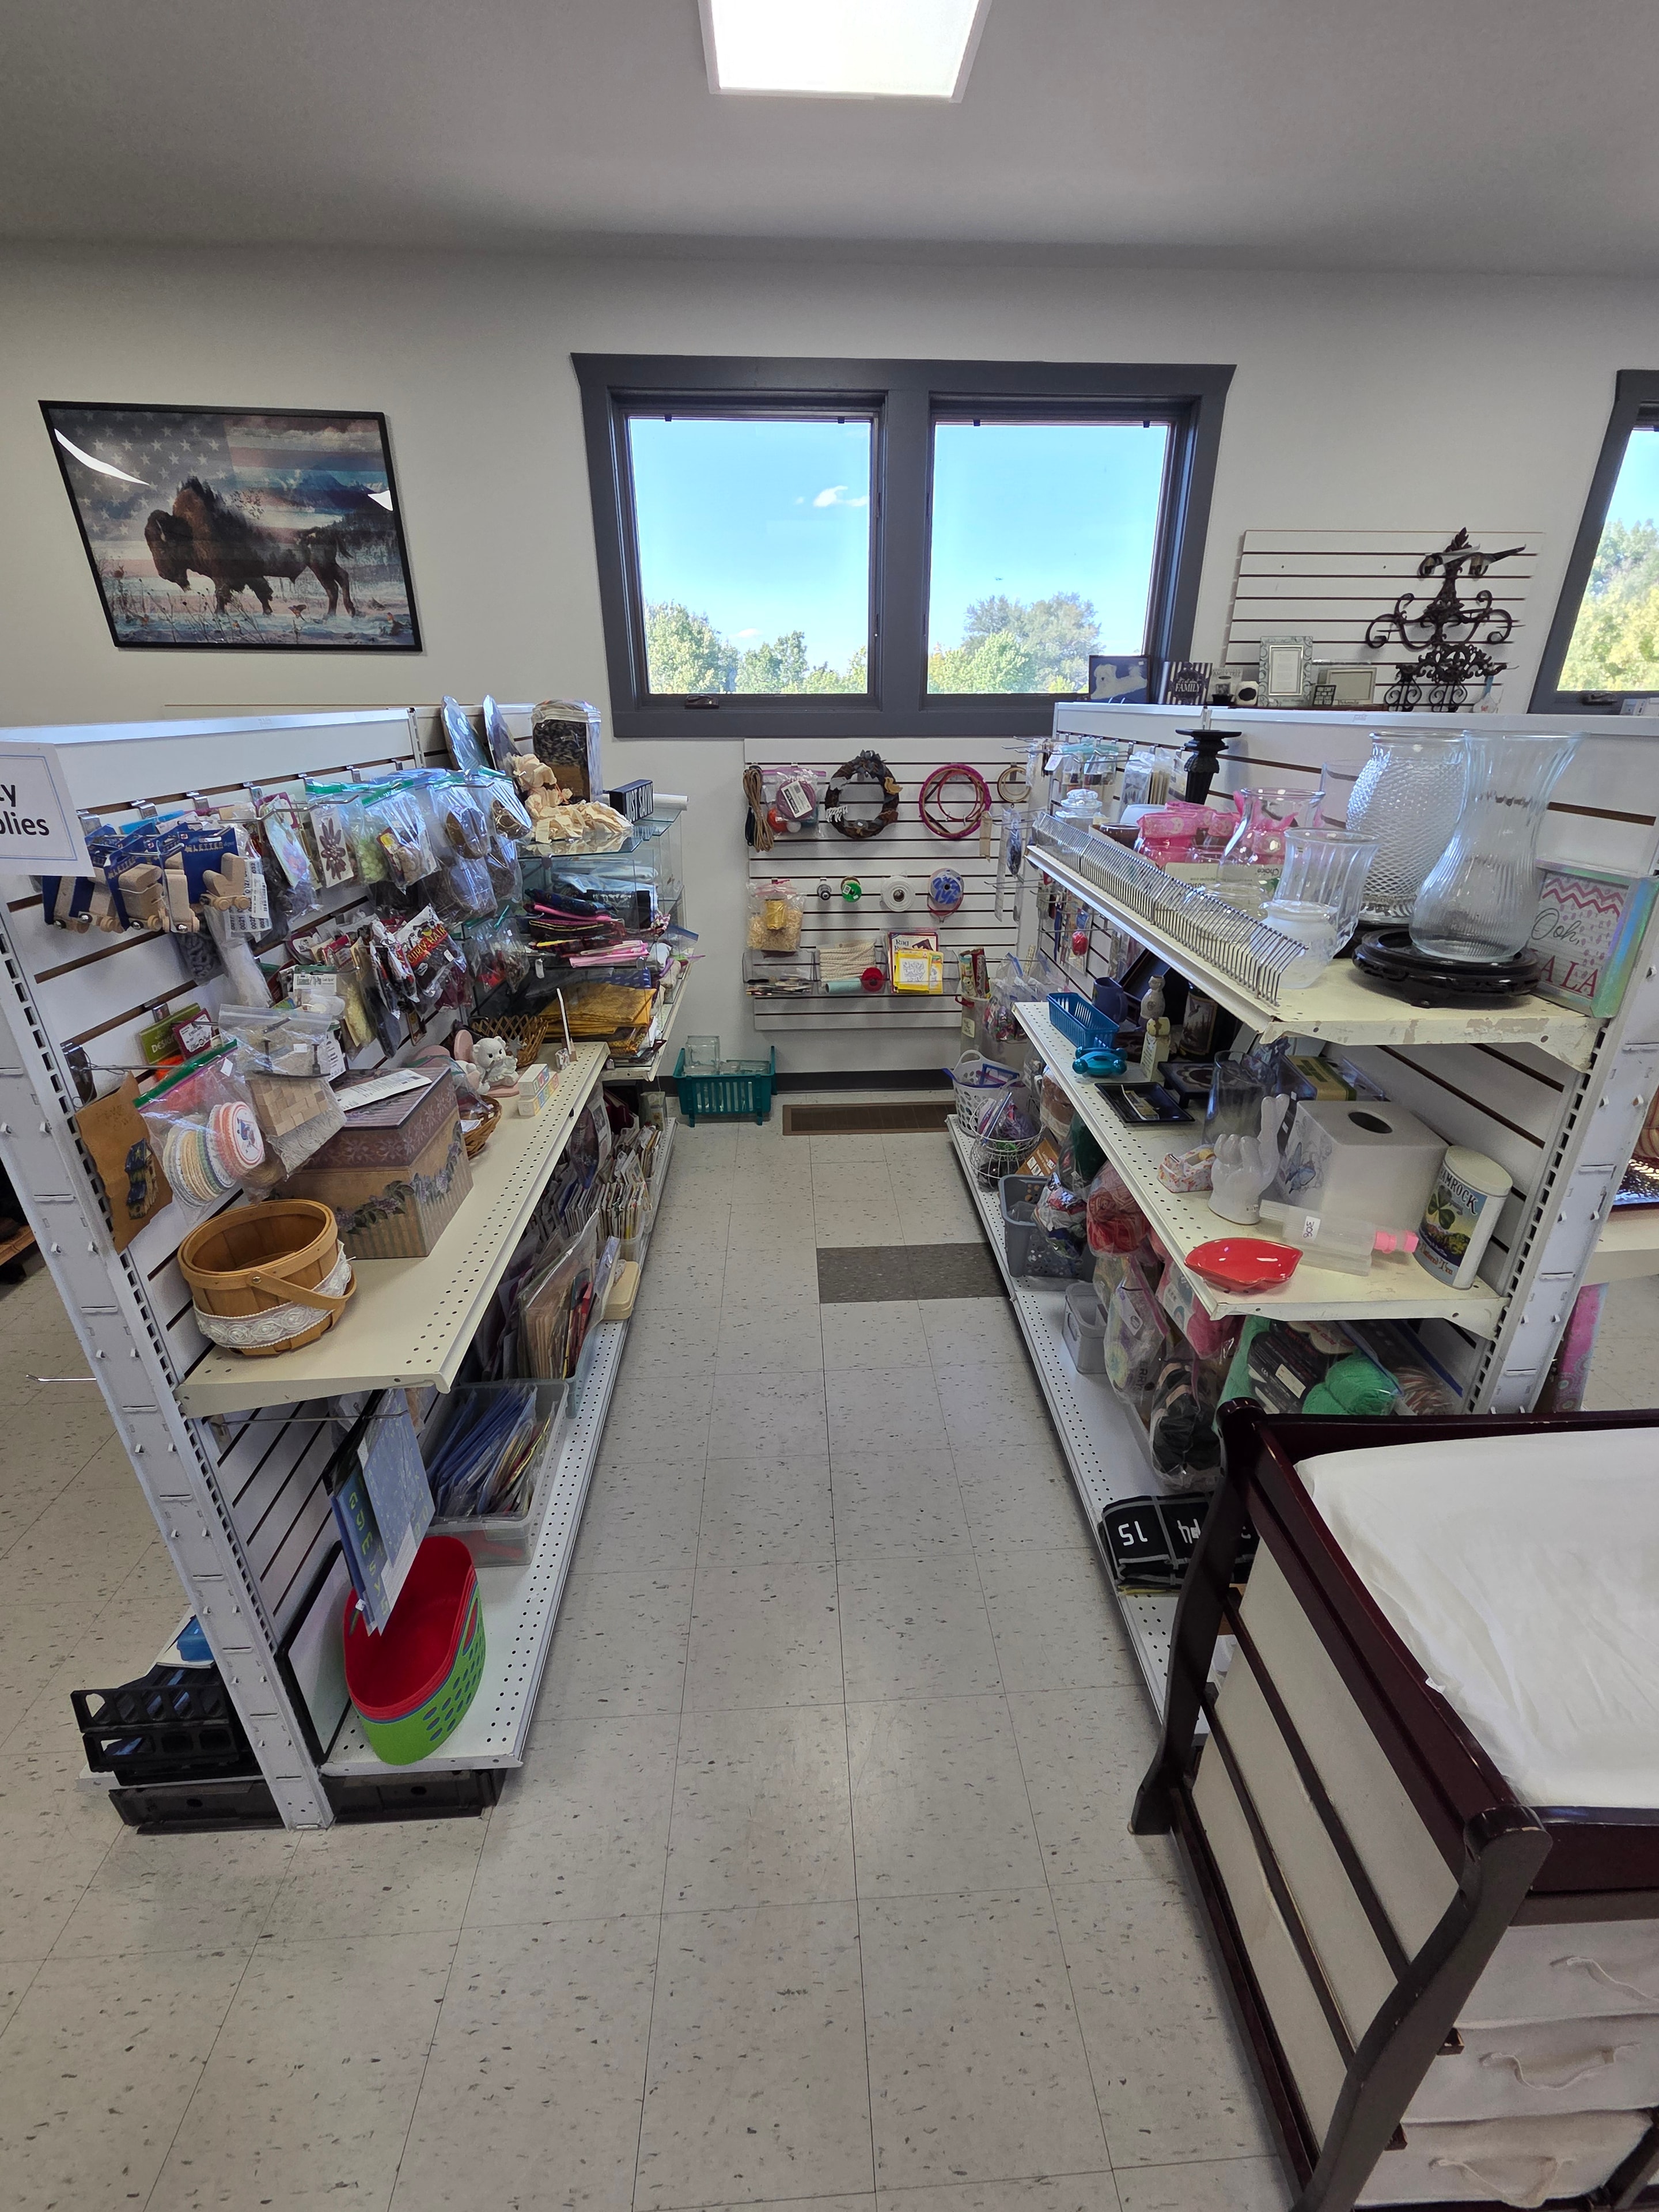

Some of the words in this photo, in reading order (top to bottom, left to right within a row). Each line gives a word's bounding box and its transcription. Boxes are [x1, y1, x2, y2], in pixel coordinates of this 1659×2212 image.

[1176, 683, 1202, 692] FAMILY
[194, 842, 224, 851] LETTER
[1257, 868, 1279, 876] Choice
[1531, 908, 1582, 945] Ooh,
[407, 941, 427, 963] CURLY
[427, 925, 447, 944] HAIR
[1559, 961, 1599, 998] LA
[1118, 1520, 1149, 1546] 15
